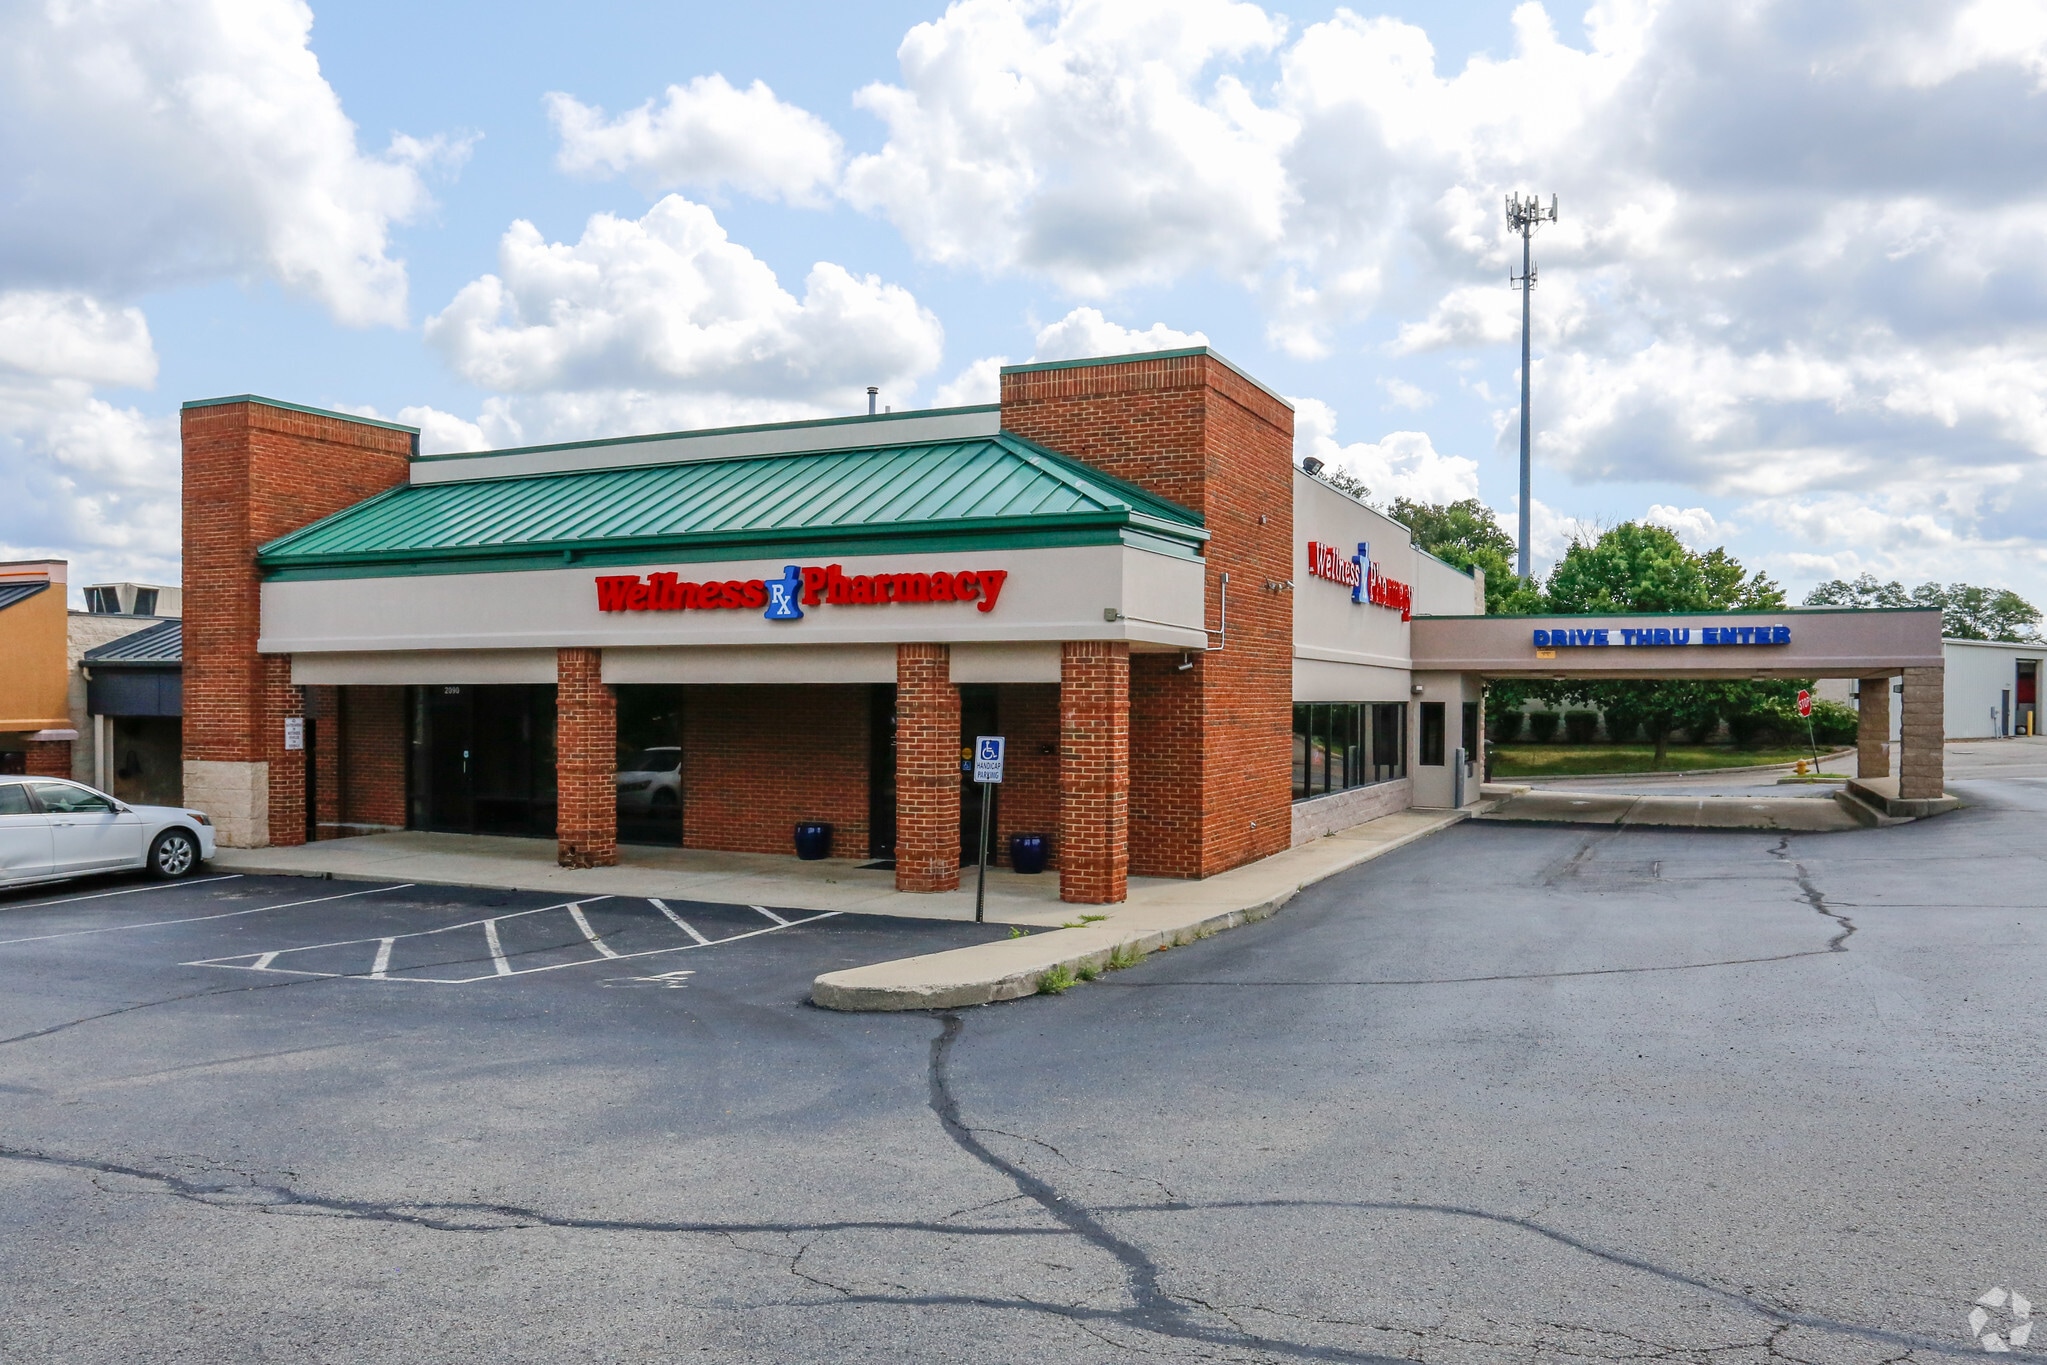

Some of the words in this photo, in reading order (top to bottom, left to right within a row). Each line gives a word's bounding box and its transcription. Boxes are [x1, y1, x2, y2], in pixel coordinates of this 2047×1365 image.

[1308, 541, 1360, 587] Wellness
[595, 572, 769, 612] Wellness
[801, 564, 1008, 612] Pharmacy
[1533, 629, 1609, 647] DRIVE
[1620, 628, 1690, 646] THRU
[1702, 626, 1792, 645] ENTER
[1798, 697, 1810, 710] STOP
[977, 771, 998, 779] PARKING
